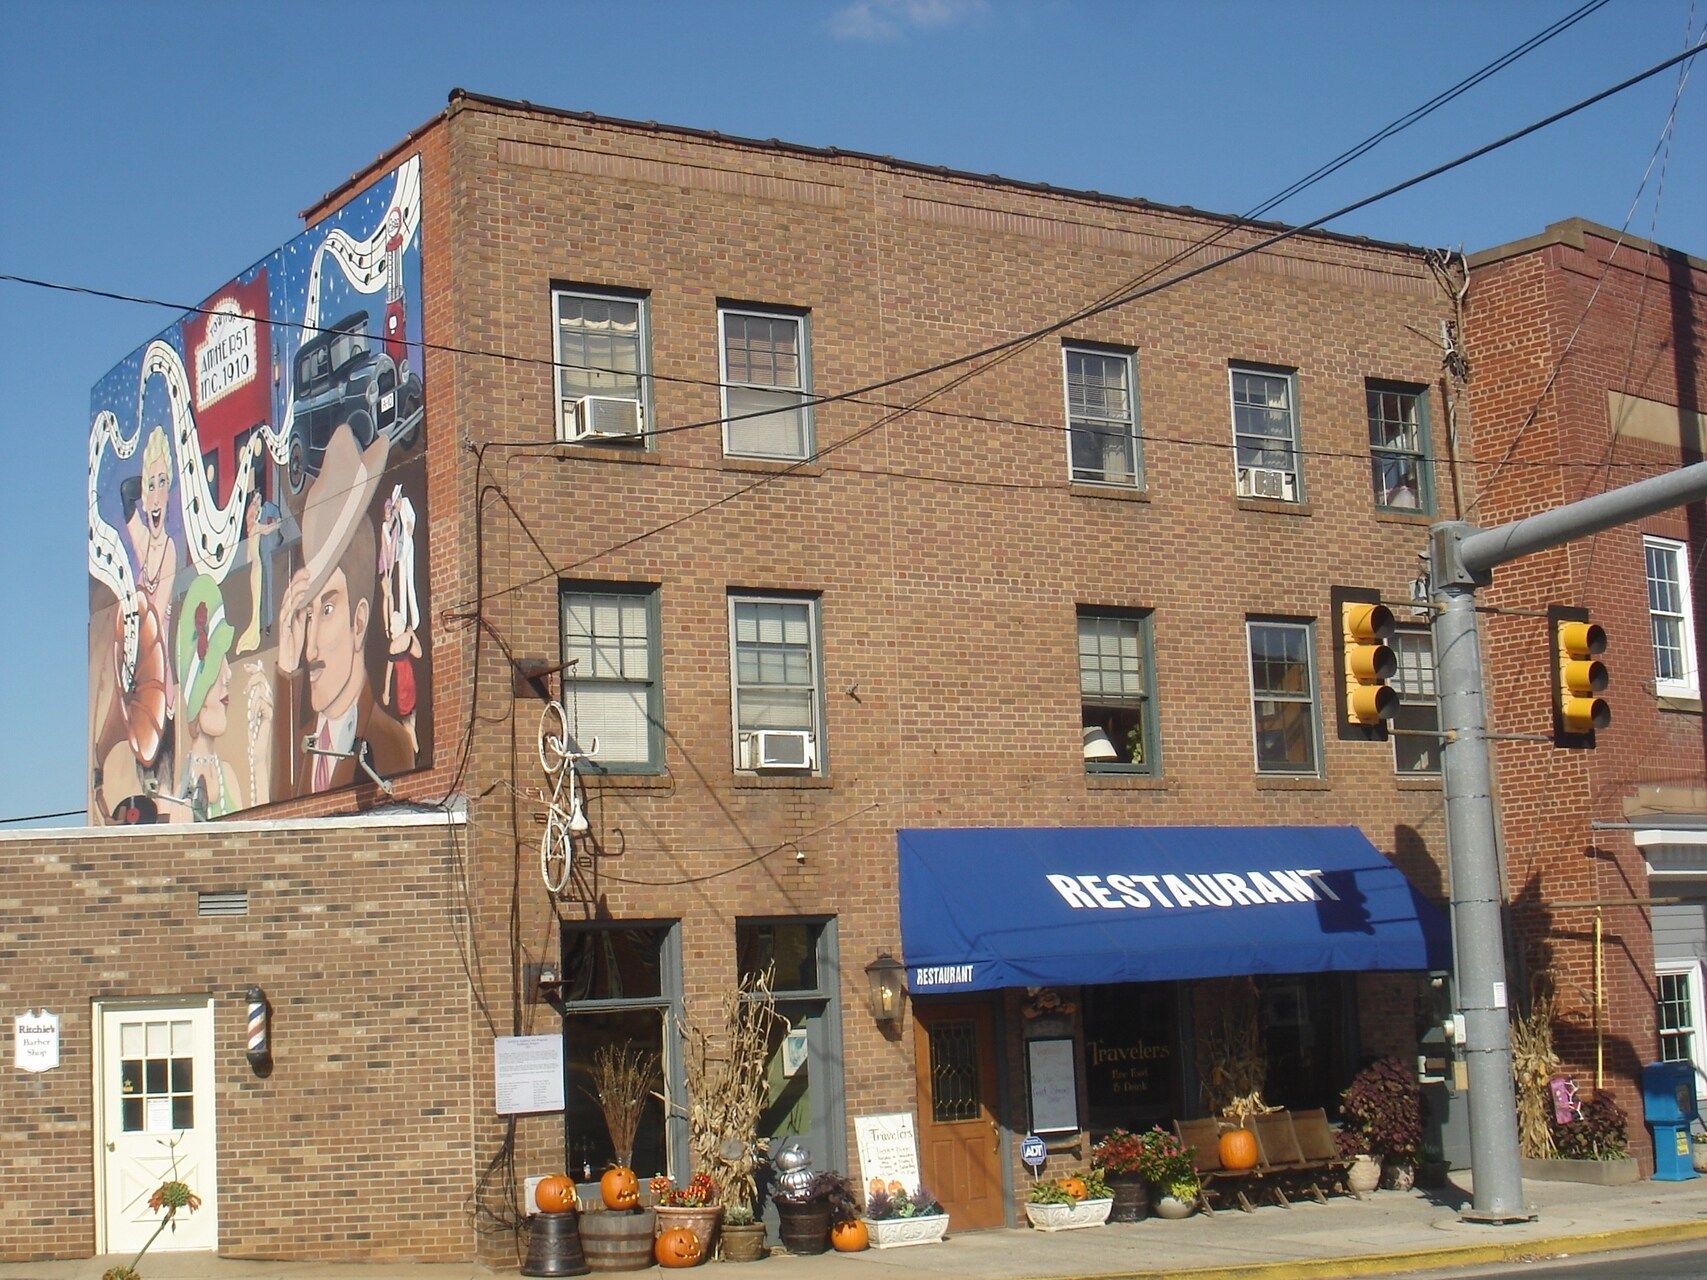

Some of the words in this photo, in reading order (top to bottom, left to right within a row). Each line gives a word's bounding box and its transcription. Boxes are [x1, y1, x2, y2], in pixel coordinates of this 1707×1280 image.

[201, 326, 249, 374] AMHERST
[222, 353, 250, 386] 1910
[1046, 869, 1341, 910] RESTAURANT
[916, 965, 974, 986] RESTAURANT
[18, 1024, 55, 1034] Ritchie's
[23, 1038, 51, 1046] Barber
[26, 1048, 47, 1058] Shop
[1087, 1039, 1170, 1066] Travelers
[868, 1128, 913, 1142] Travelers
[1025, 1145, 1042, 1157] ADT
